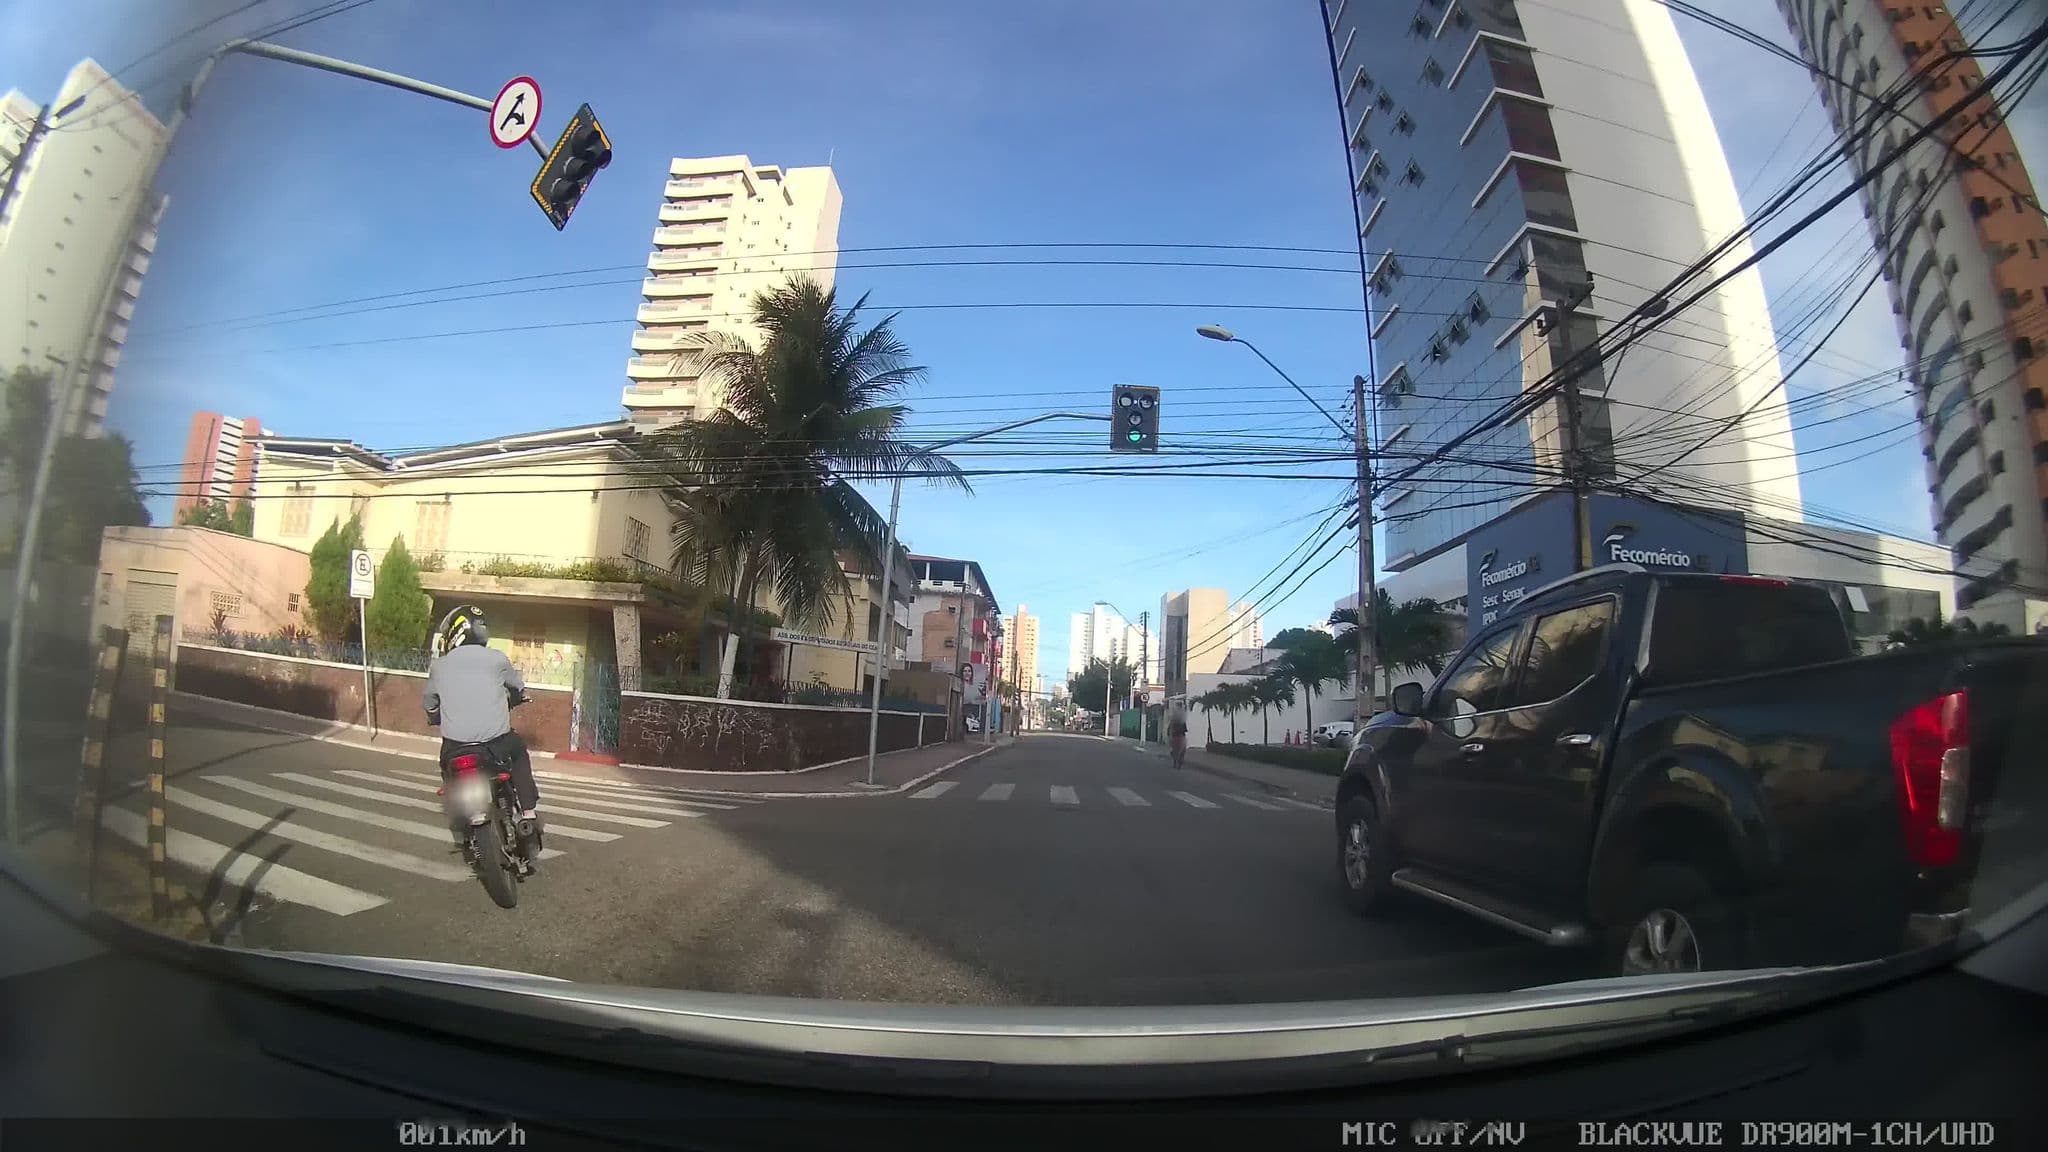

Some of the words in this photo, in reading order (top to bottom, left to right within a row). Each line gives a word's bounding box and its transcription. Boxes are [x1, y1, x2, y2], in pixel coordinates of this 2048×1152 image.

[1611, 544, 1690, 567] Fecomércio
[1482, 560, 1527, 587] Fecomércio
[1482, 594, 1499, 608] Sesc
[1502, 587, 1526, 602] Senac
